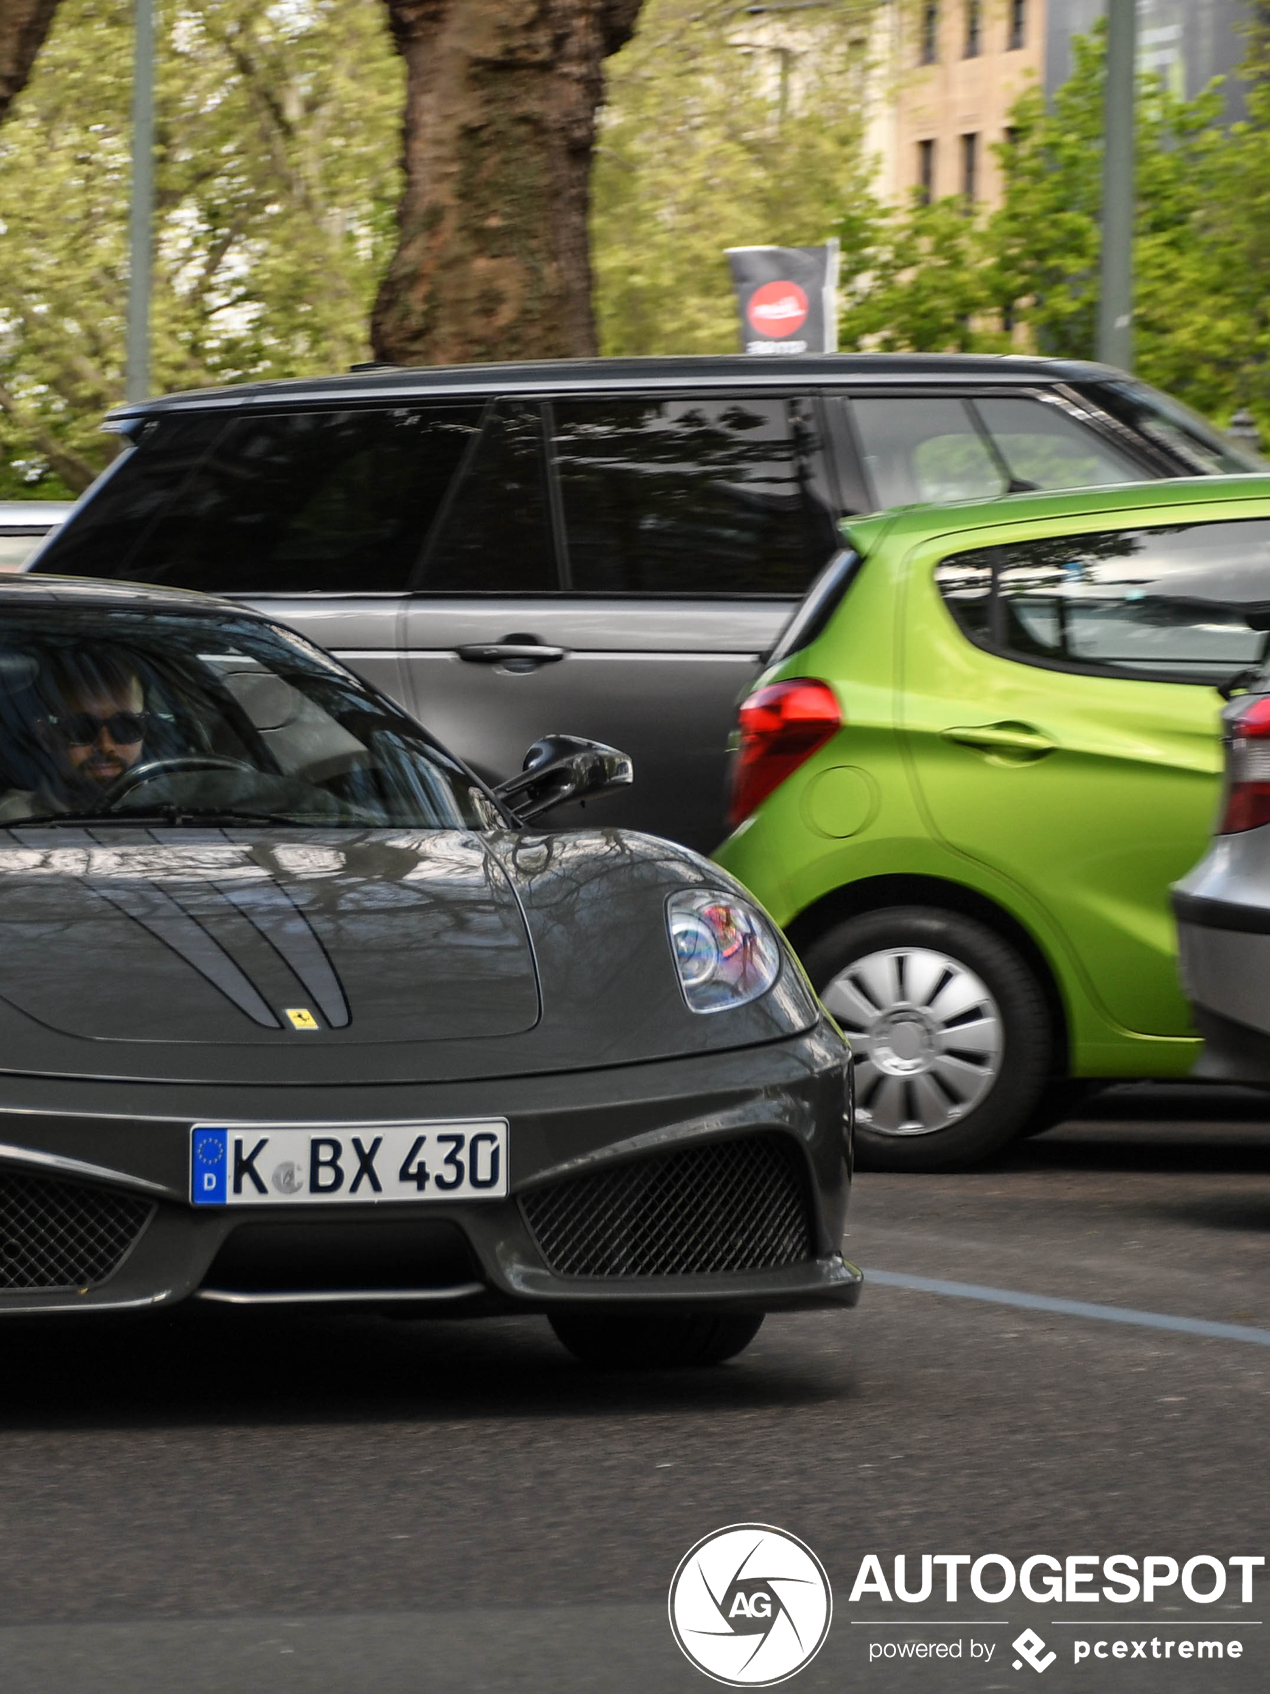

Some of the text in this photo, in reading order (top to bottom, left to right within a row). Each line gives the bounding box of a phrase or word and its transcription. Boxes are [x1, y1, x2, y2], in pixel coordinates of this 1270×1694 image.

[204, 1174, 216, 1191] D
[233, 1132, 500, 1194] K BX 430
